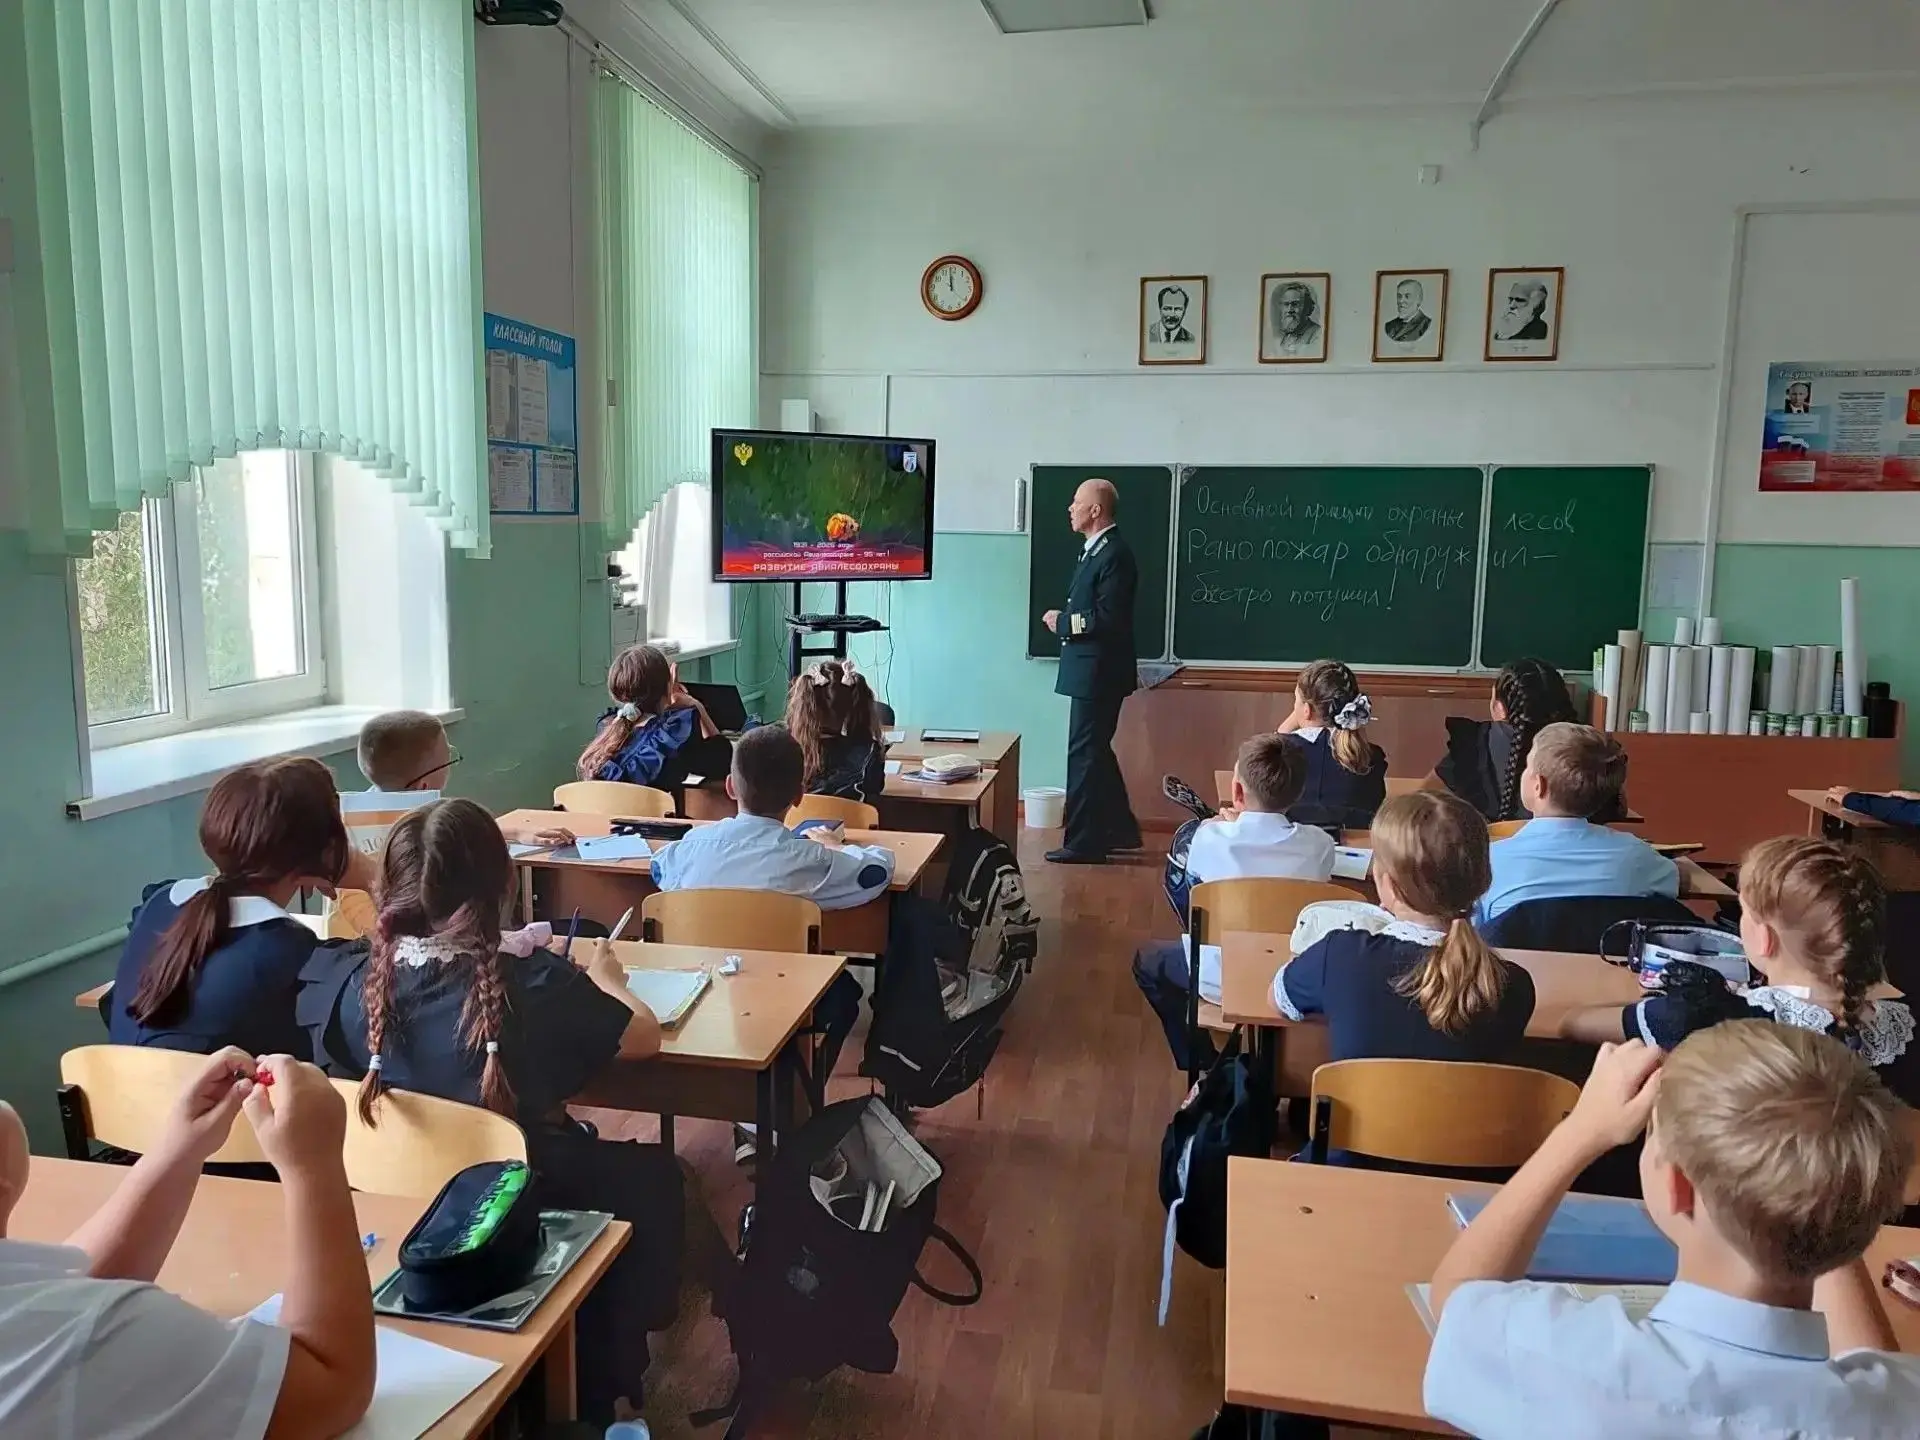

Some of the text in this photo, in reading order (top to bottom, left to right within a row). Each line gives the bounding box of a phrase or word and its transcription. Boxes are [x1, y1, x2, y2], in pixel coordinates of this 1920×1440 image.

[493, 321, 564, 356] КЛАССНЫЙ УГОЛОК
[1503, 498, 1577, 533] лесов
[753, 562, 900, 573] РАЗВИТИЕ АВИАЛЕСООХРАНЫ
[1188, 528, 1254, 563] Рано
[1262, 540, 1349, 580] пожар
